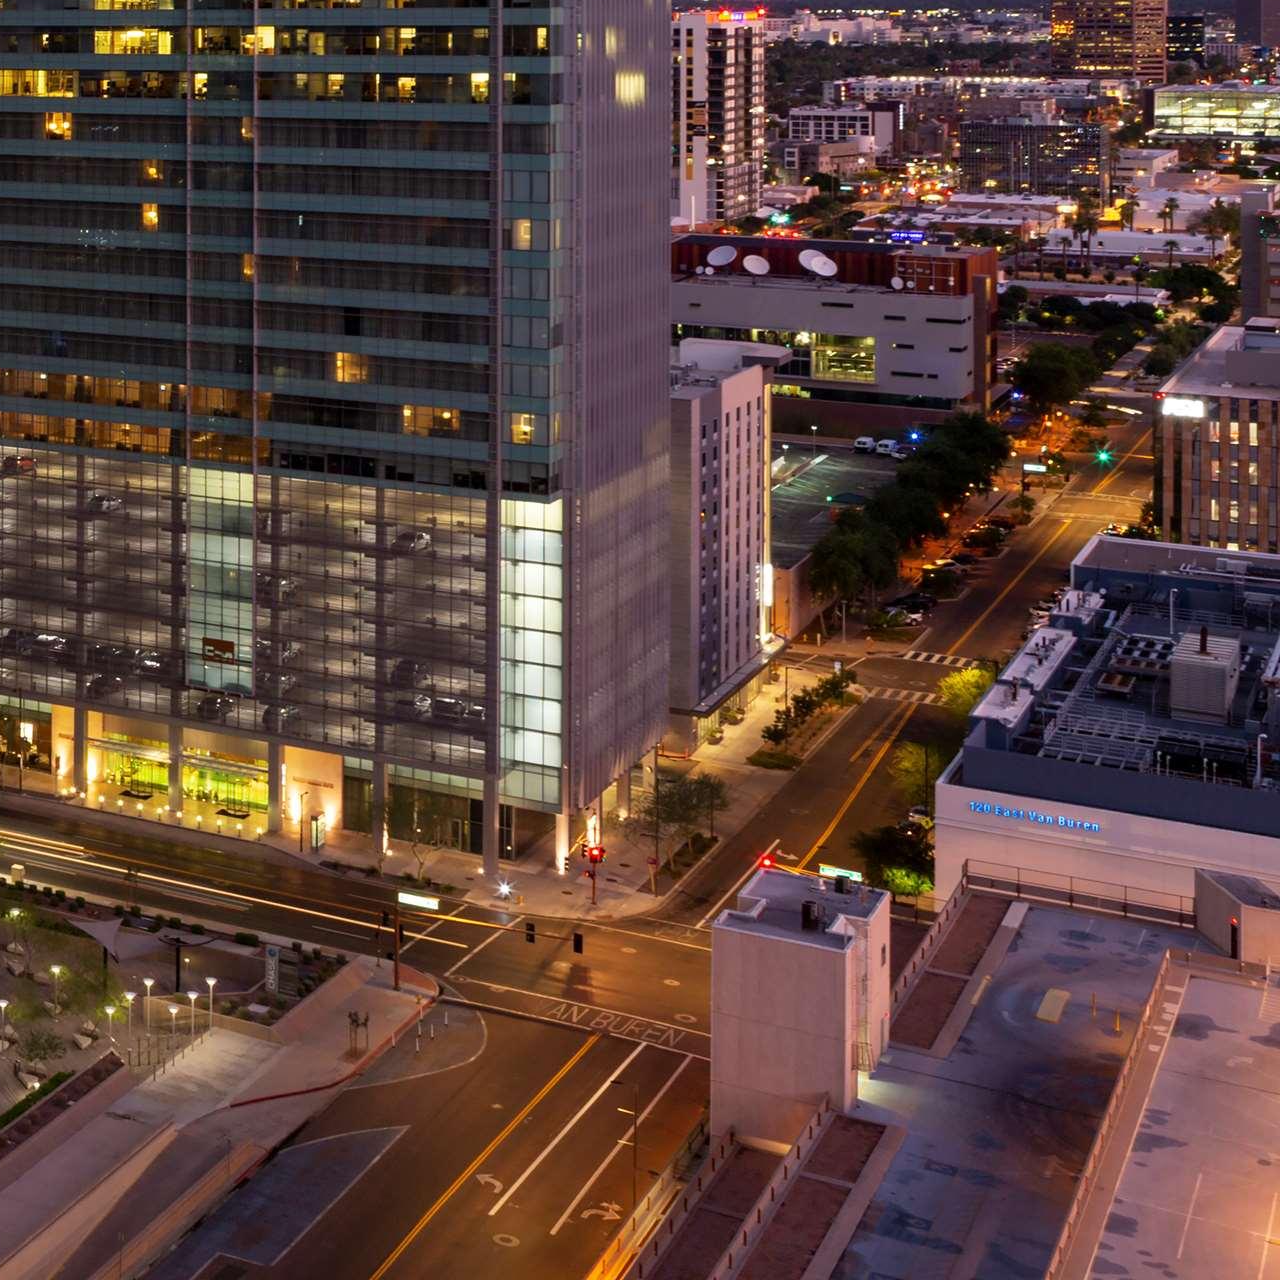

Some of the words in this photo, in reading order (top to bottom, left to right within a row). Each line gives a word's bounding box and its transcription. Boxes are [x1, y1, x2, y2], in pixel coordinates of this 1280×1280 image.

[969, 800, 992, 814] 120
[994, 805, 1025, 820] East
[1027, 811, 1054, 825] Van
[1058, 815, 1100, 833] Buren
[590, 1012, 687, 1047] BUREN
